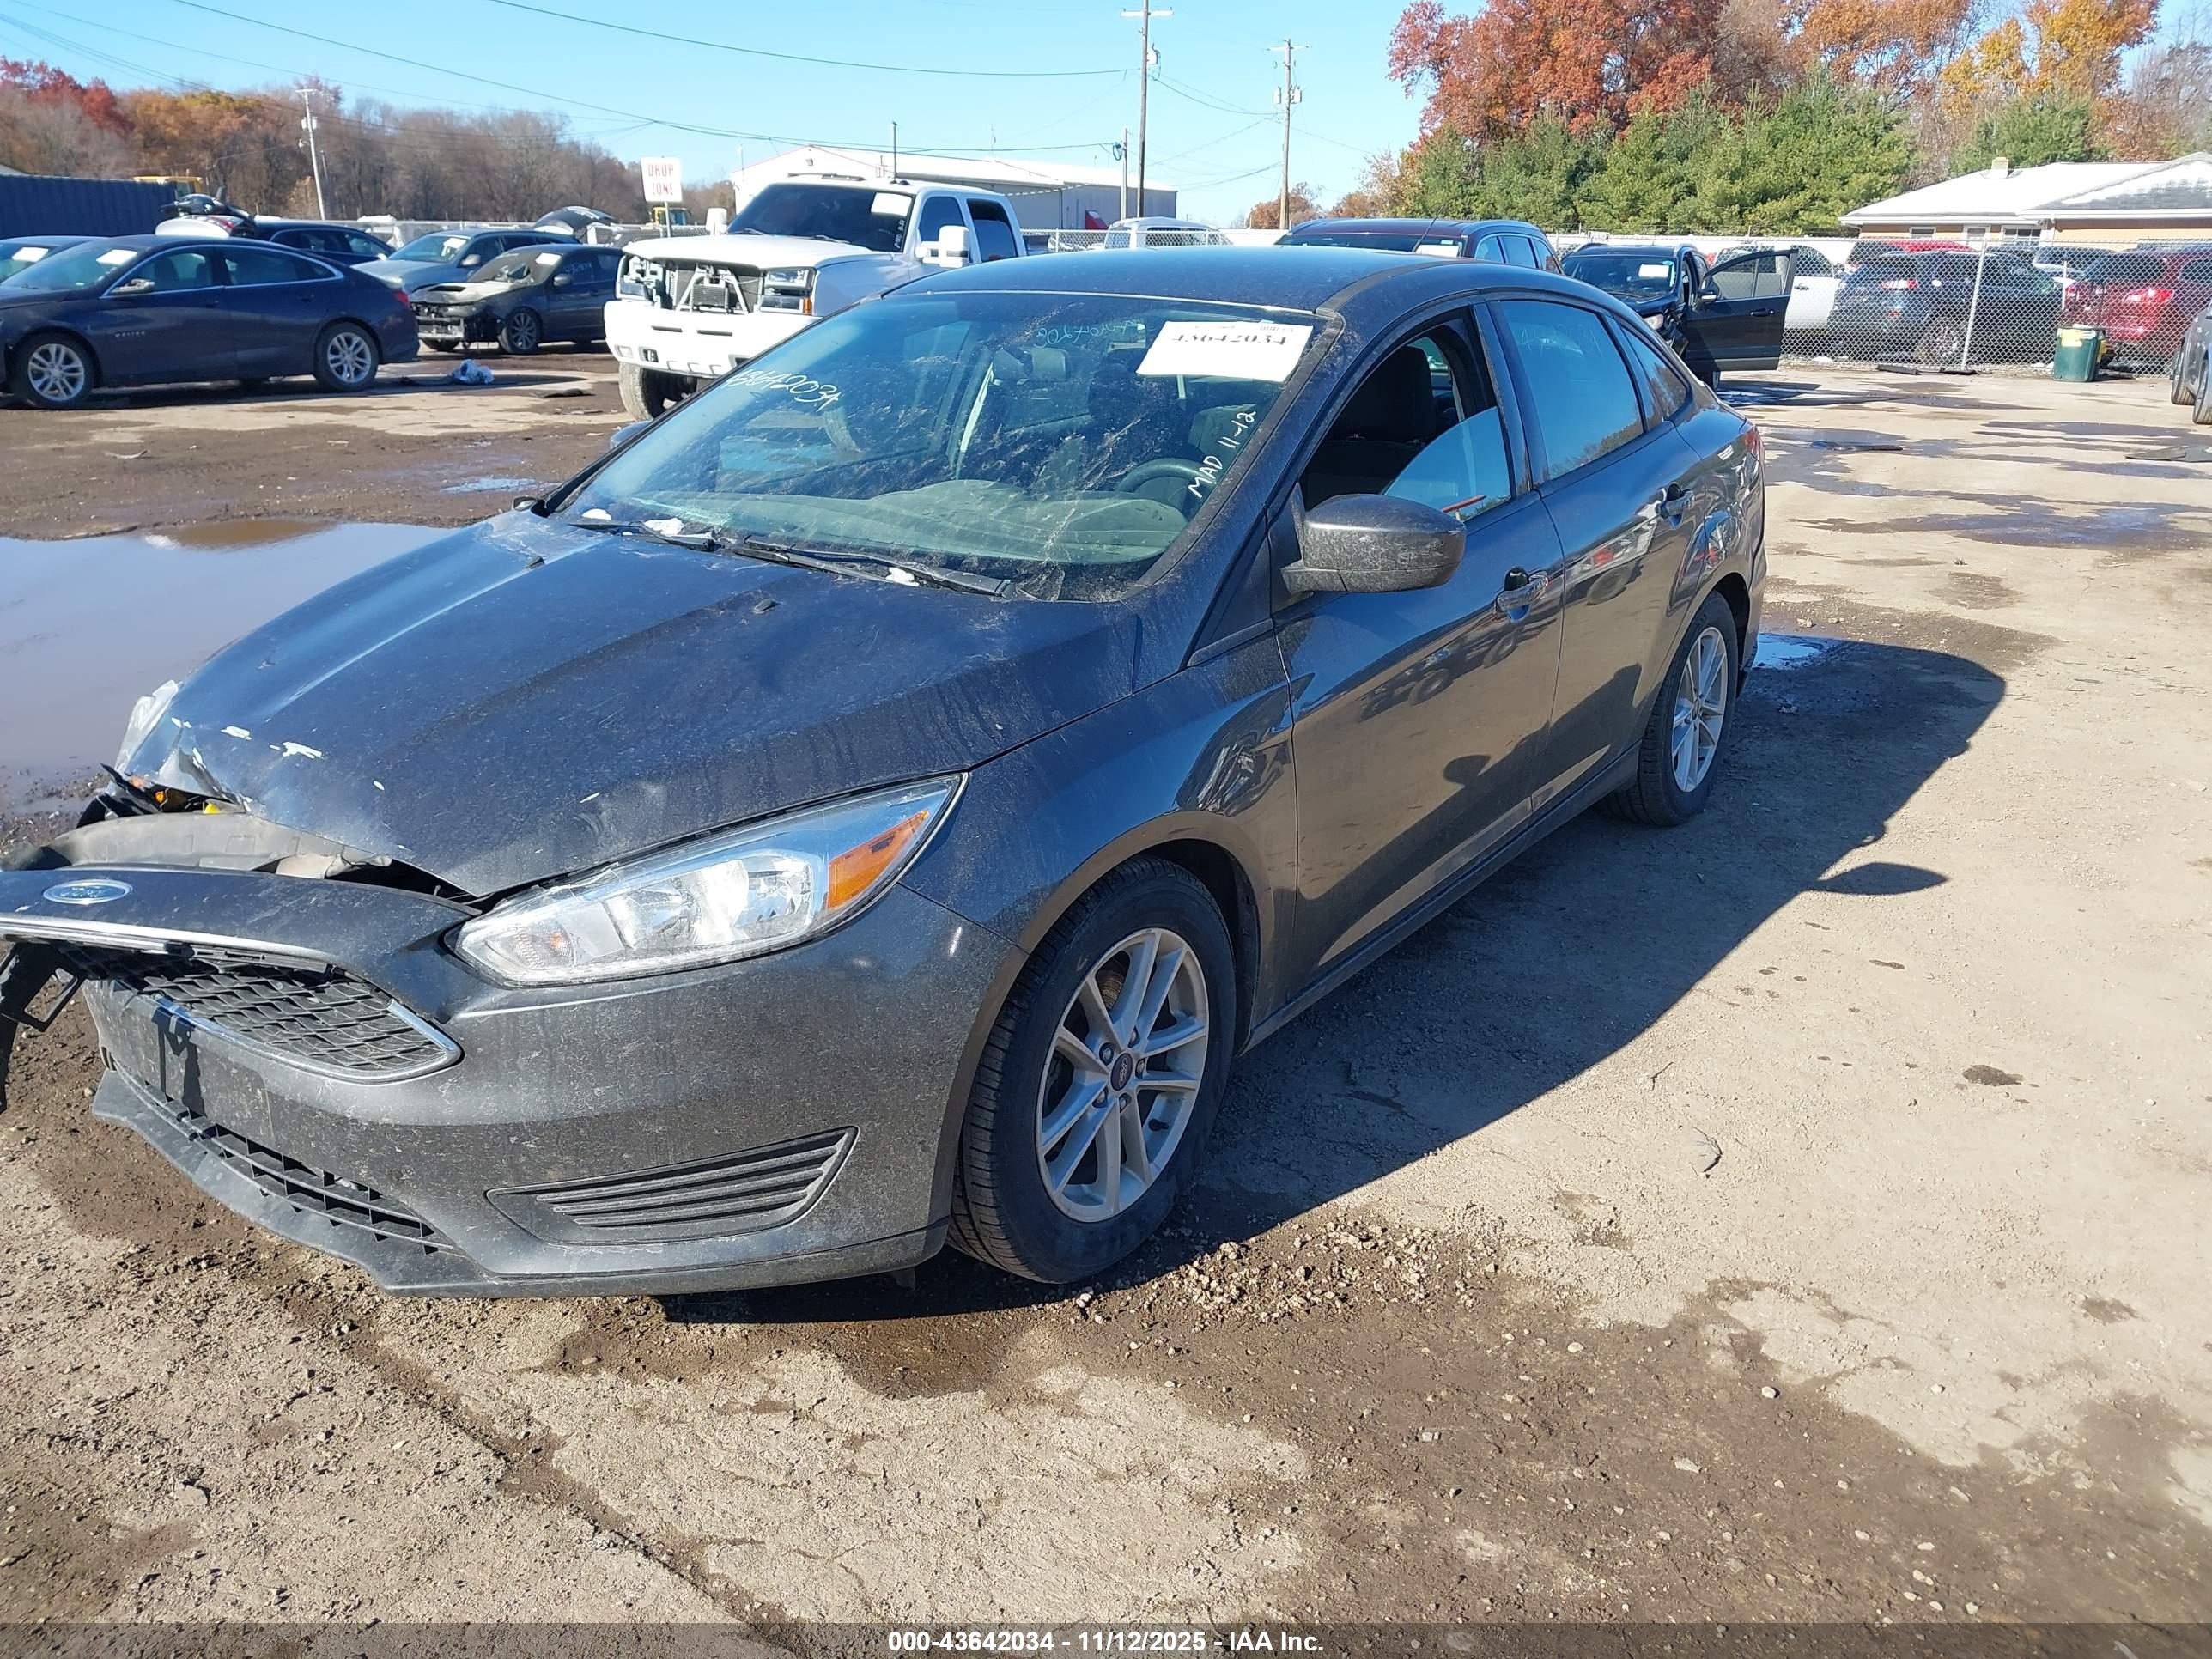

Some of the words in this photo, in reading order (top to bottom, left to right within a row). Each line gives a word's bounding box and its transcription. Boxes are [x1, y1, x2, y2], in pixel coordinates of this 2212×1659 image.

[647, 164, 674, 177] DROP
[652, 182, 674, 196] ZONE
[1171, 334, 1288, 345] 43642034
[1188, 455, 1223, 498] MAD
